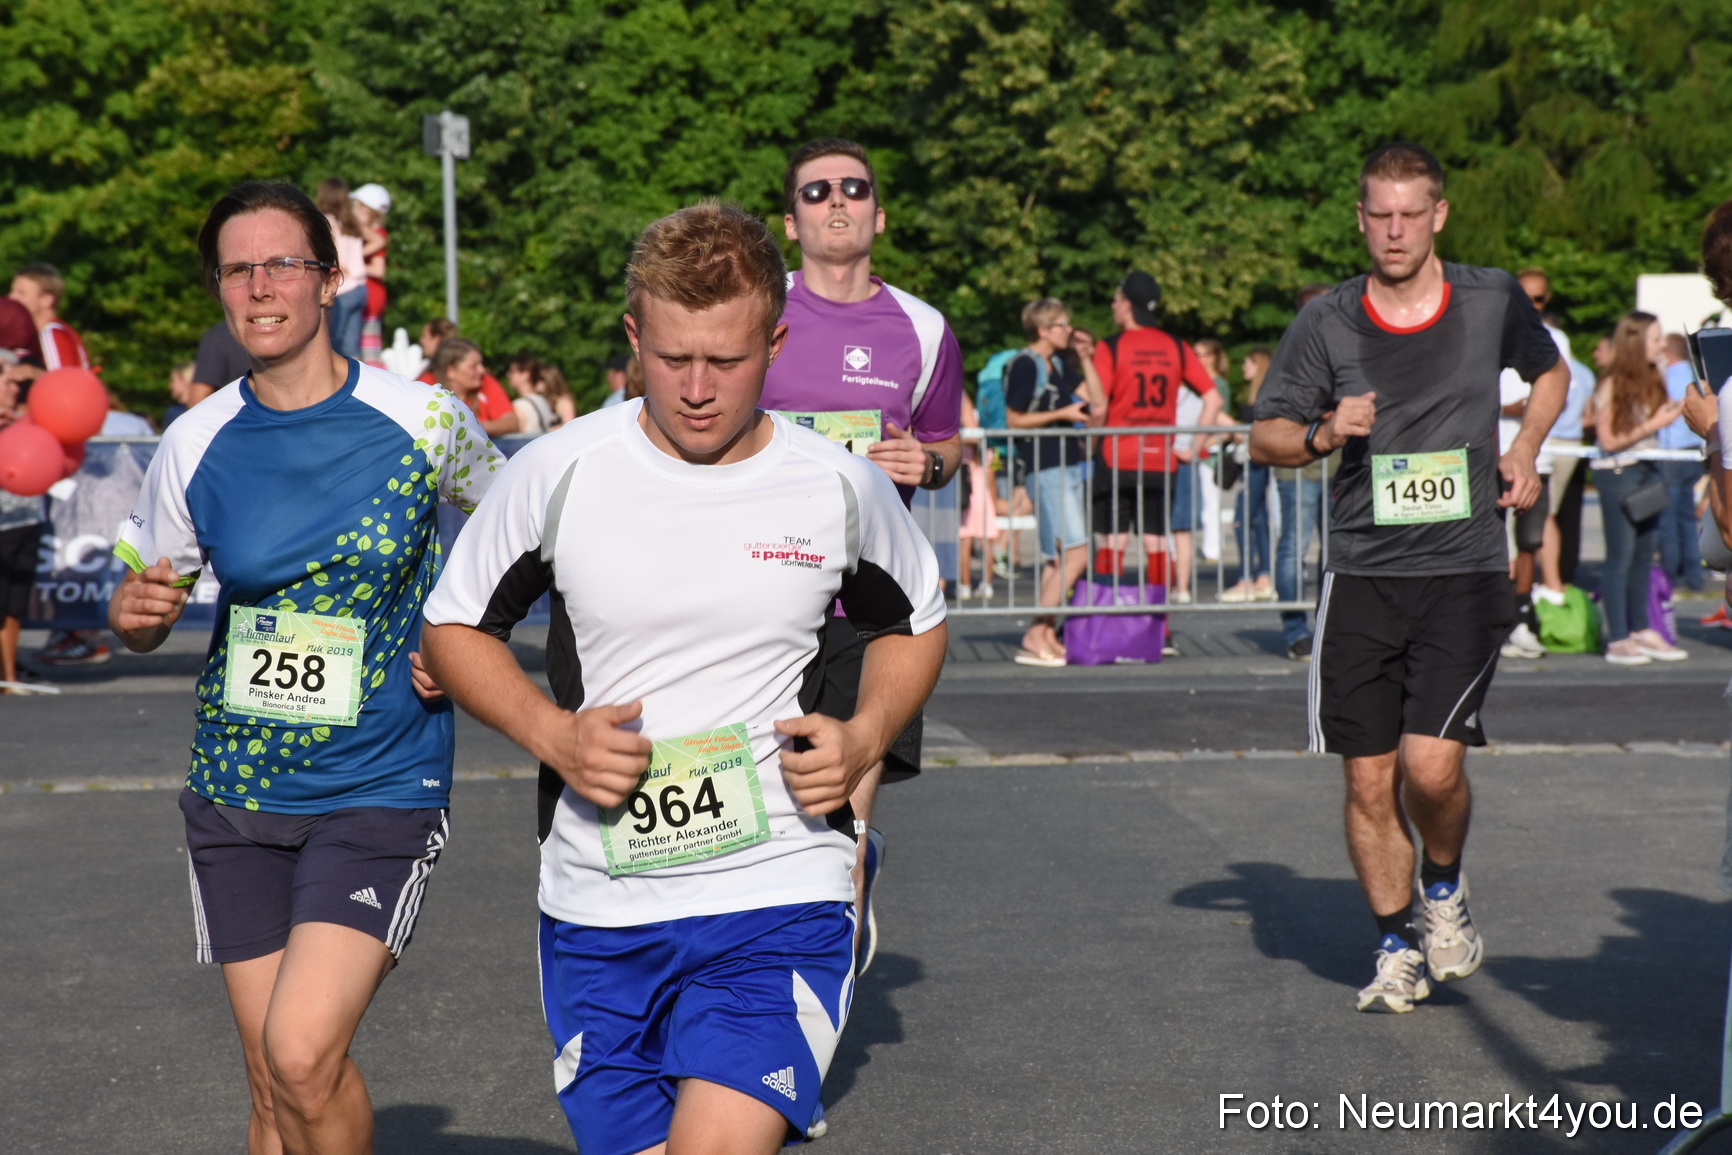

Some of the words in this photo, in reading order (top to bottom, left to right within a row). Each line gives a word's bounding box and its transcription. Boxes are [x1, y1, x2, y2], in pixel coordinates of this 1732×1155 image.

[842, 374, 899, 390] Fertigteilwerke
[1133, 372, 1168, 408] 13
[1385, 477, 1455, 504] 1490
[743, 542, 802, 552] guttenberger
[783, 536, 811, 546] TEAM
[762, 550, 826, 563] partner
[781, 559, 823, 570] LICHTWERBUNG
[246, 627, 296, 644] firmenlauf
[326, 646, 354, 657] 2019
[249, 648, 325, 693] 258
[248, 688, 284, 701] Pinsker
[287, 692, 326, 705] Andrea
[262, 701, 295, 711] Bionorica
[296, 704, 306, 712] SE
[640, 763, 672, 780] nlauf
[713, 757, 742, 773] 2019
[628, 776, 724, 835] 964
[628, 834, 672, 850] Richter
[675, 819, 738, 841] Alexander
[629, 845, 681, 862] guttenberger
[684, 838, 713, 852] partner
[715, 828, 742, 842] GmbH
[349, 893, 382, 910] adidas
[761, 1075, 797, 1101] adidas
